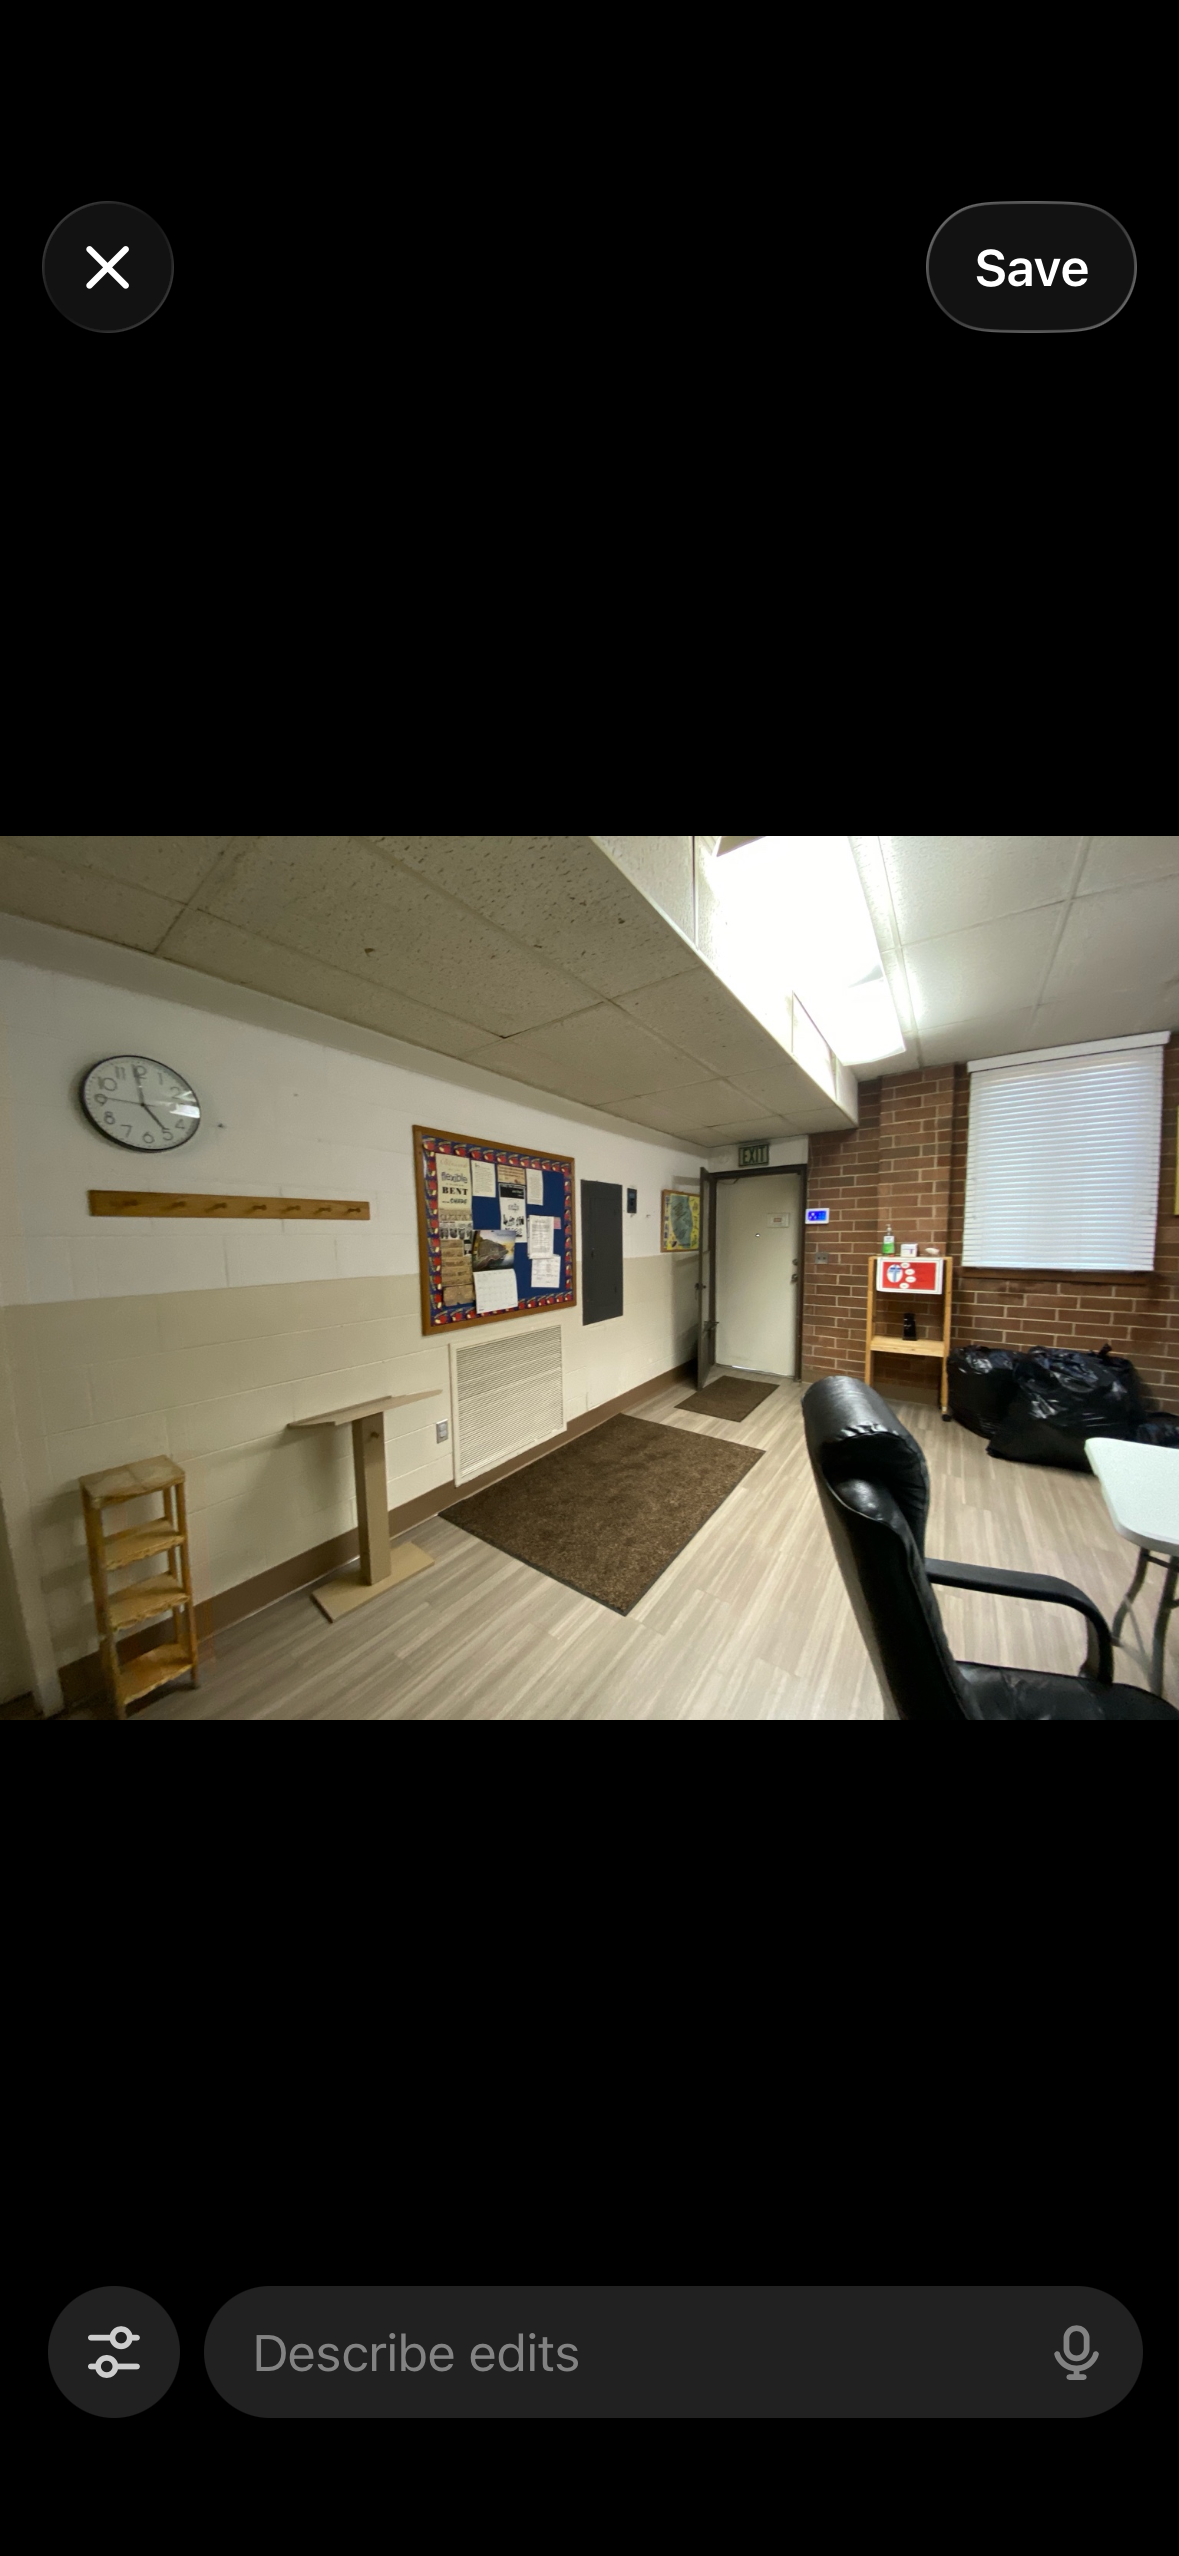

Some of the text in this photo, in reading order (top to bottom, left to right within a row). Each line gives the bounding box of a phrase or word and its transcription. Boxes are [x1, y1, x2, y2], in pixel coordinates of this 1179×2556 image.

[115, 1066, 126, 1080] 11
[158, 1072, 163, 1085] 1
[97, 1077, 118, 1092] 10
[94, 1093, 108, 1106] 9
[170, 1086, 181, 1100] 2
[103, 1111, 116, 1125] 8
[175, 1118, 186, 1130] 4
[120, 1124, 133, 1138] 7
[142, 1131, 155, 1144] 6
[162, 1127, 174, 1141] 5
[743, 1145, 766, 1165] EXIT
[442, 1186, 468, 1196] BENT
